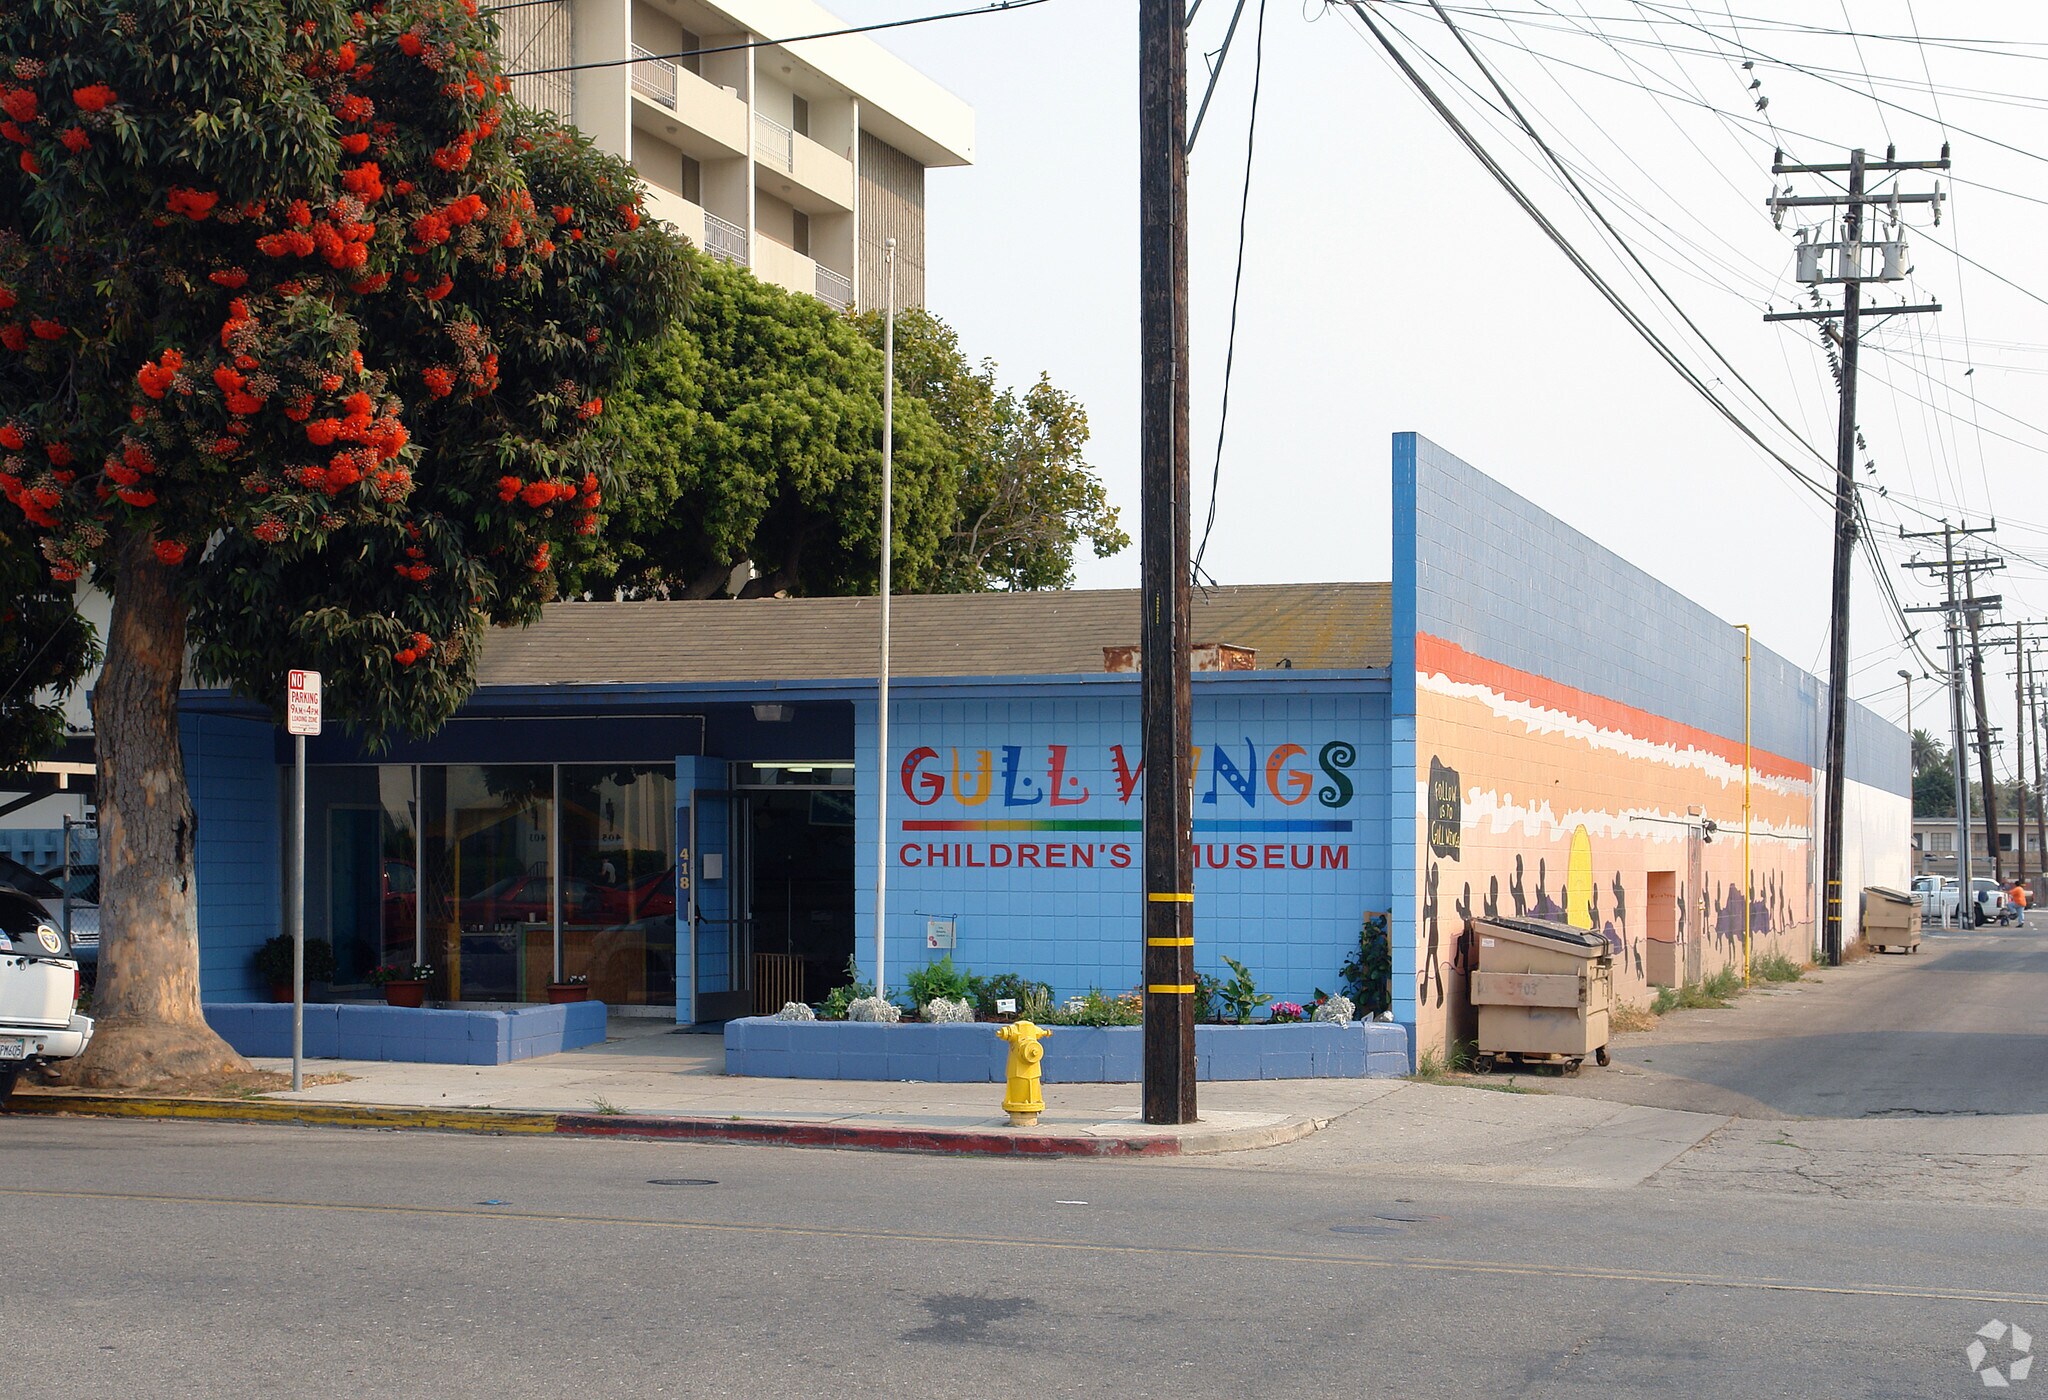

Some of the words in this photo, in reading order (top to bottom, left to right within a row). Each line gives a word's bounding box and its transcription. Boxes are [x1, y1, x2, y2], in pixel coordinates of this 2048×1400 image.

[291, 673, 303, 688] NO
[291, 691, 319, 704] PARKING
[901, 744, 1091, 808] GULL
[899, 843, 1131, 868] CHILDREN'S
[680, 848, 690, 889] 418
